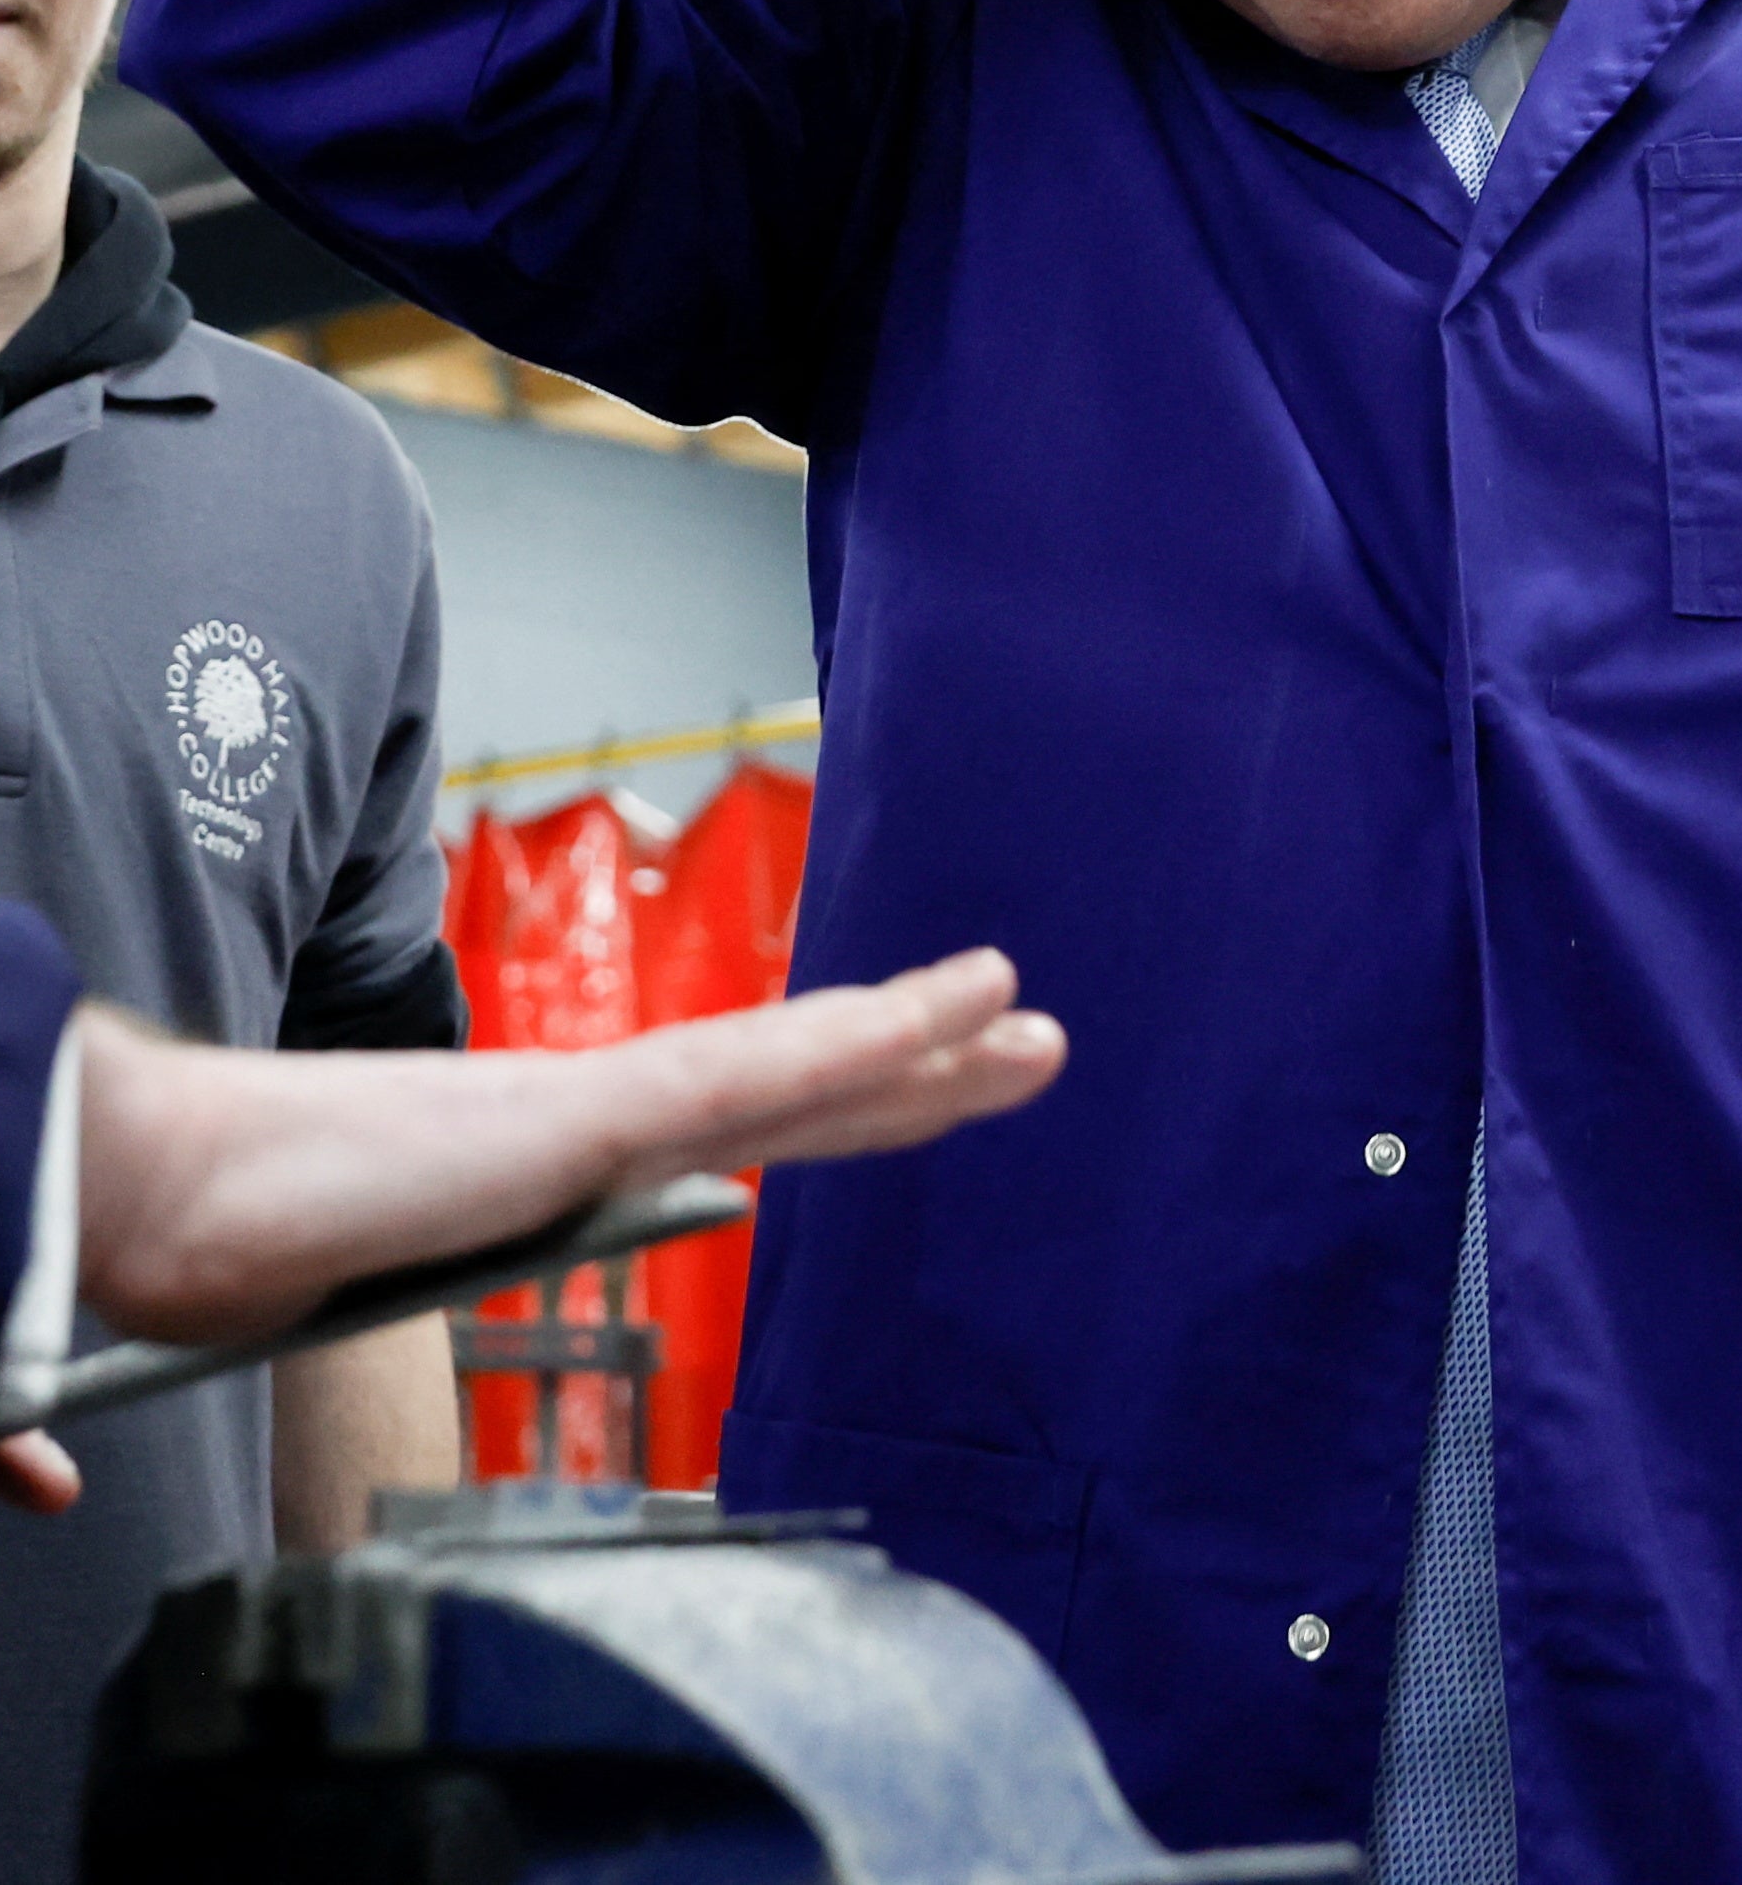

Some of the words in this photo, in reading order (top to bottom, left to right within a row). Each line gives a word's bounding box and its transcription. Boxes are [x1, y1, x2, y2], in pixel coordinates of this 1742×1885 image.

[165, 619, 264, 714] HOPWOOD
[260, 659, 290, 747] HALL
[177, 732, 278, 804] COLLEGE
